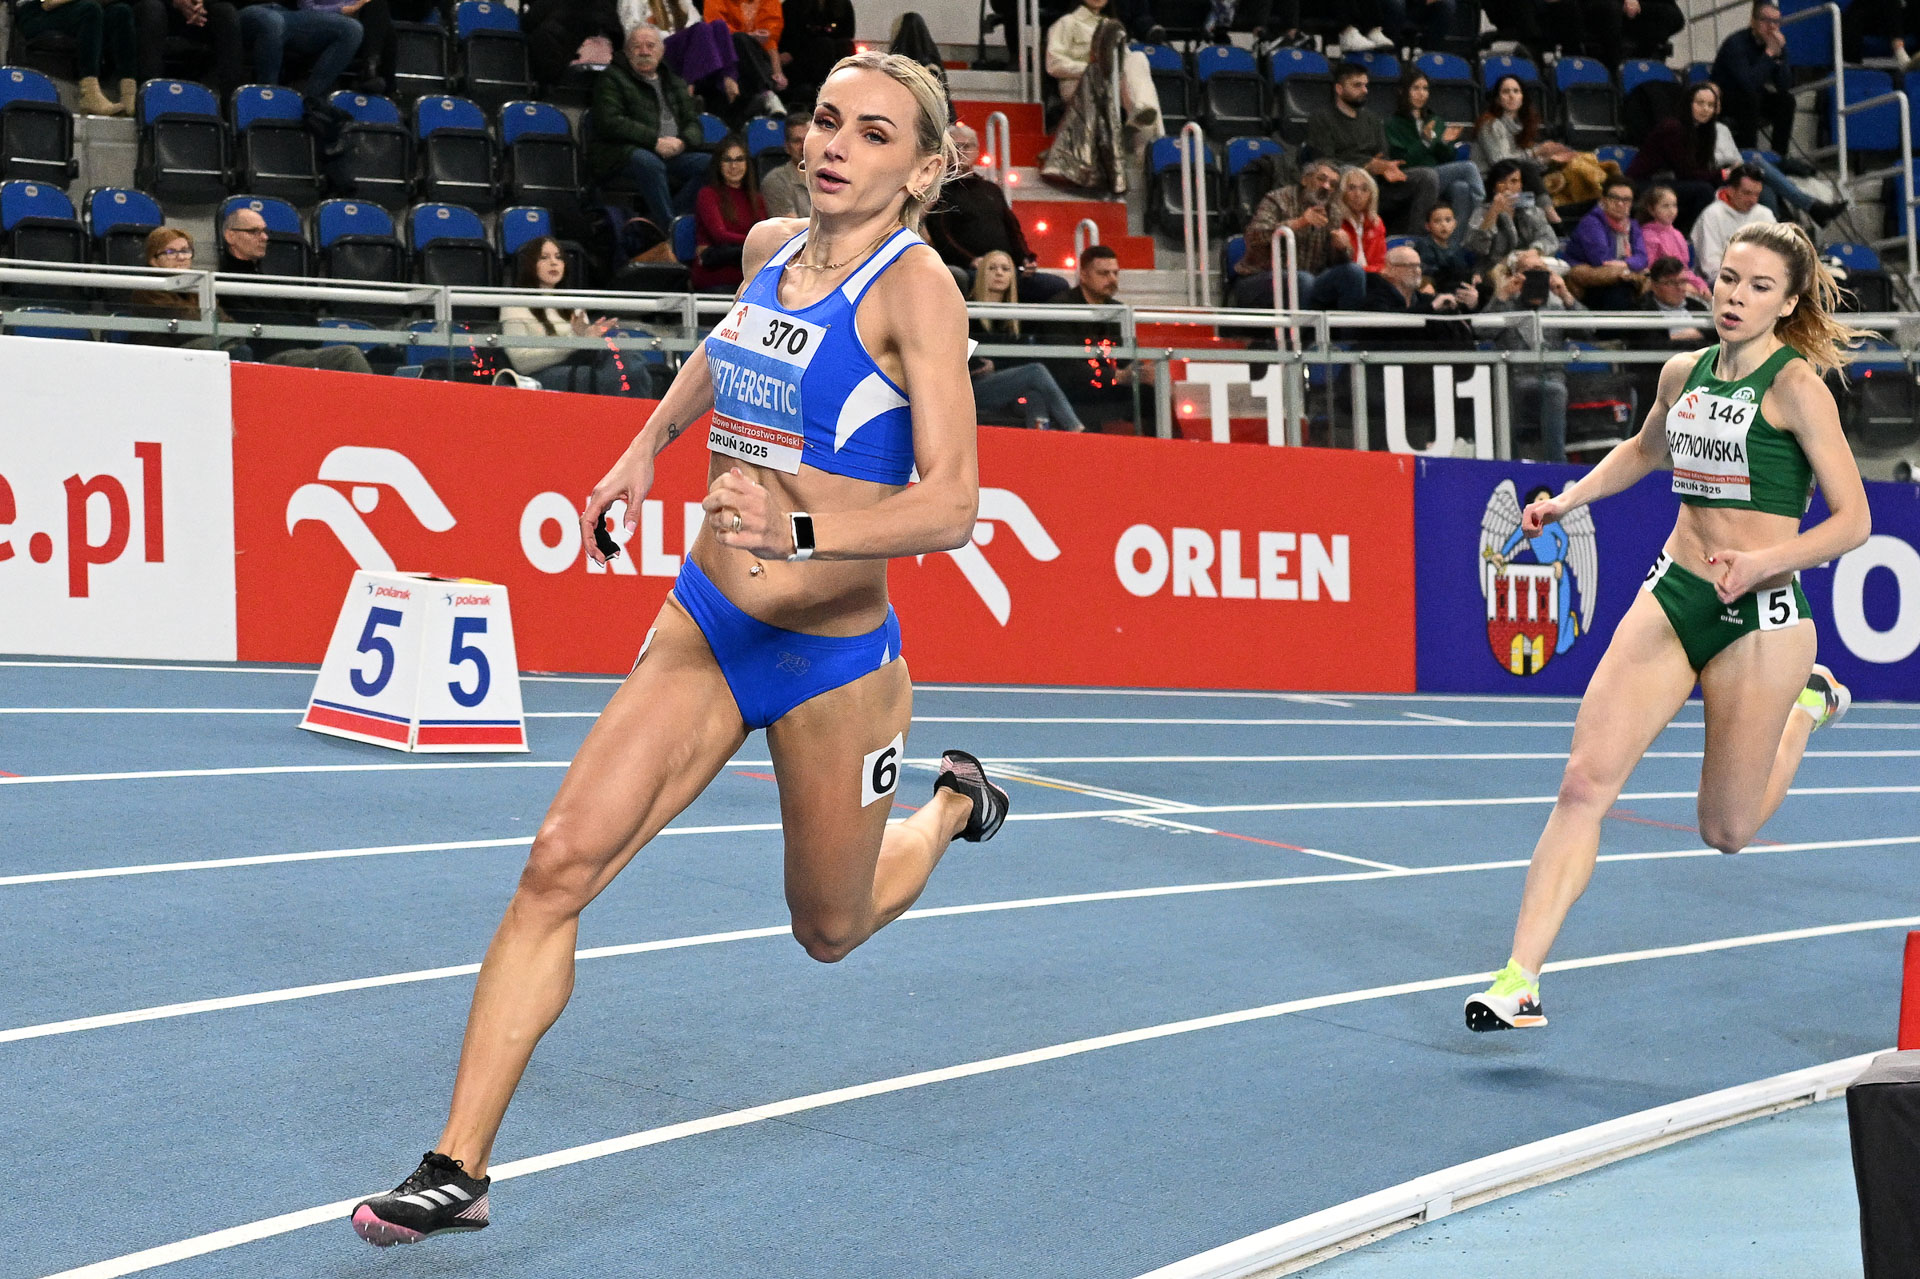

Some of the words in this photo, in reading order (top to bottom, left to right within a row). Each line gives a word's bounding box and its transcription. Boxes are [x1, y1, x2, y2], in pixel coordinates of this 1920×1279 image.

[720, 328, 740, 341] ORLEN
[762, 319, 808, 355] 370
[1186, 363, 1285, 447] T1
[1383, 365, 1494, 460] U1
[1708, 401, 1746, 424] 146
[730, 422, 775, 441] Mistrzostwa
[776, 434, 800, 447] Polski
[739, 441, 768, 458] 2025
[1114, 523, 1350, 602] ORLEN
[375, 586, 411, 600] polanik
[455, 594, 491, 607] polanik
[1769, 589, 1791, 625] 5
[350, 606, 403, 697] 5
[448, 617, 490, 708] 5
[872, 747, 897, 795] 6
